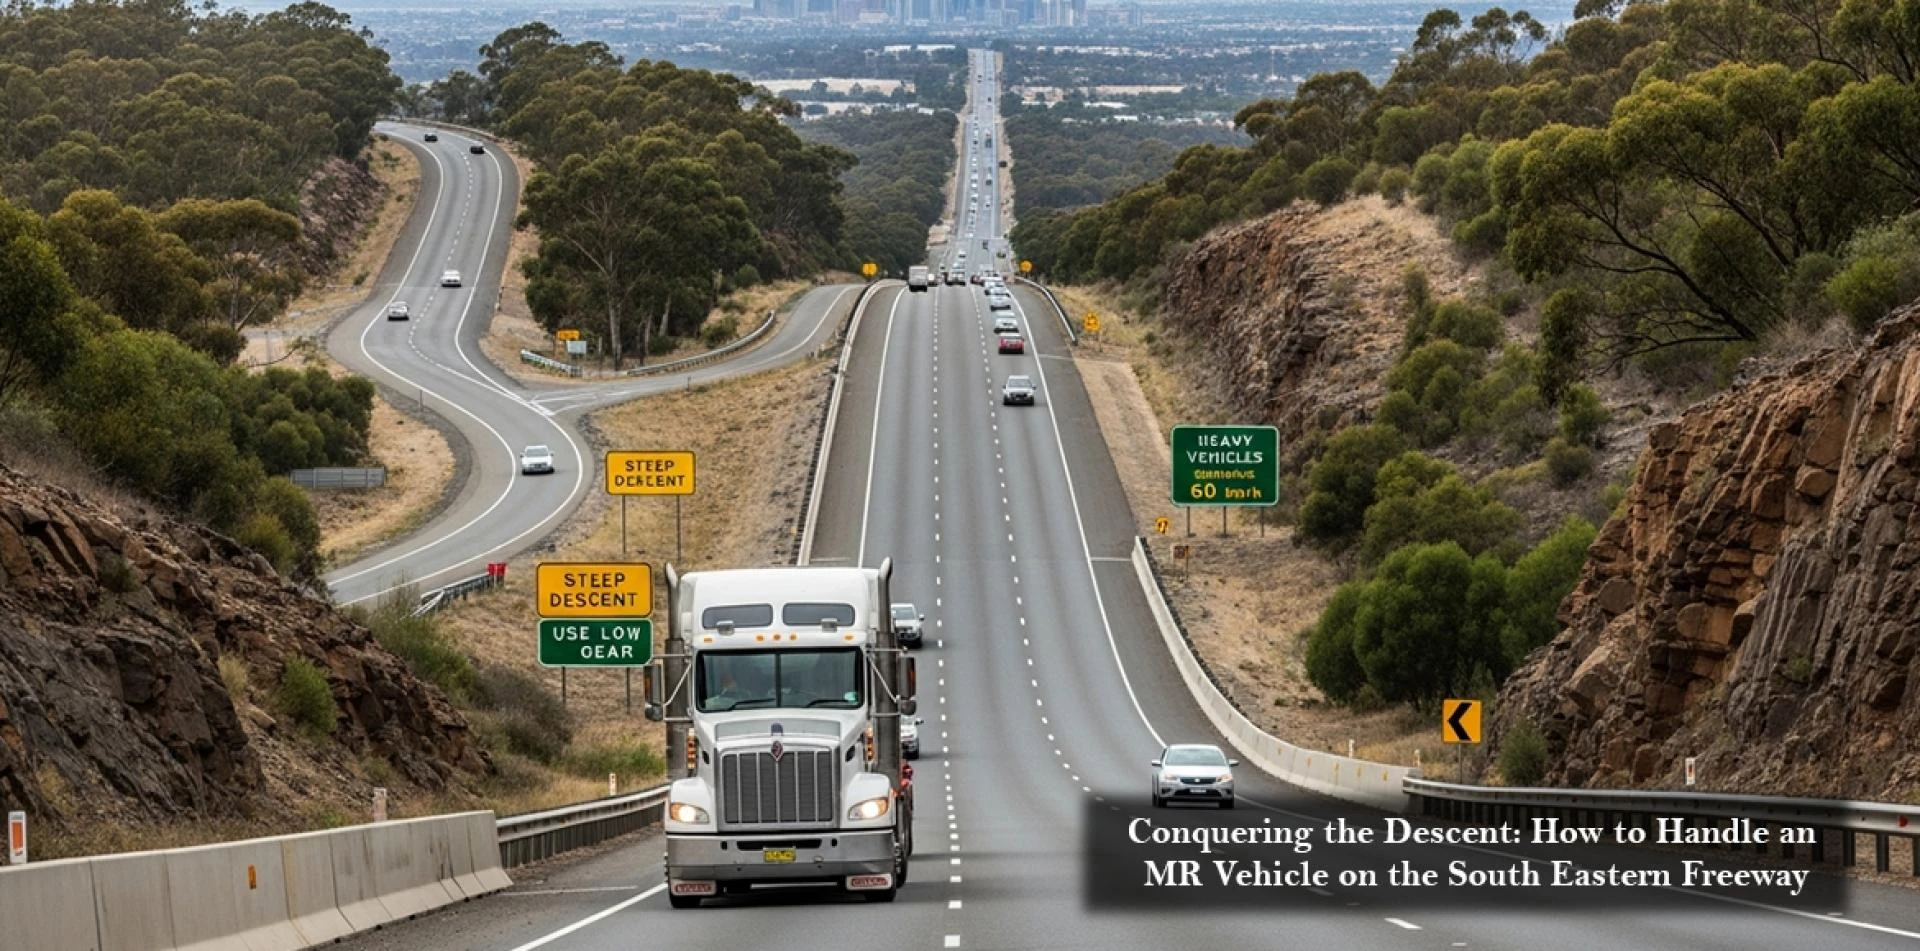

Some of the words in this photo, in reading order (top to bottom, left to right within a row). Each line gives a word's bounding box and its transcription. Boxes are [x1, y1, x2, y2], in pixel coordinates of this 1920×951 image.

[625, 460, 674, 472] STEEP
[1190, 483, 1217, 499] 60
[564, 572, 626, 588] STEEP
[550, 592, 638, 607] DESCENT
[552, 626, 590, 641] USE
[601, 626, 641, 641] LOW
